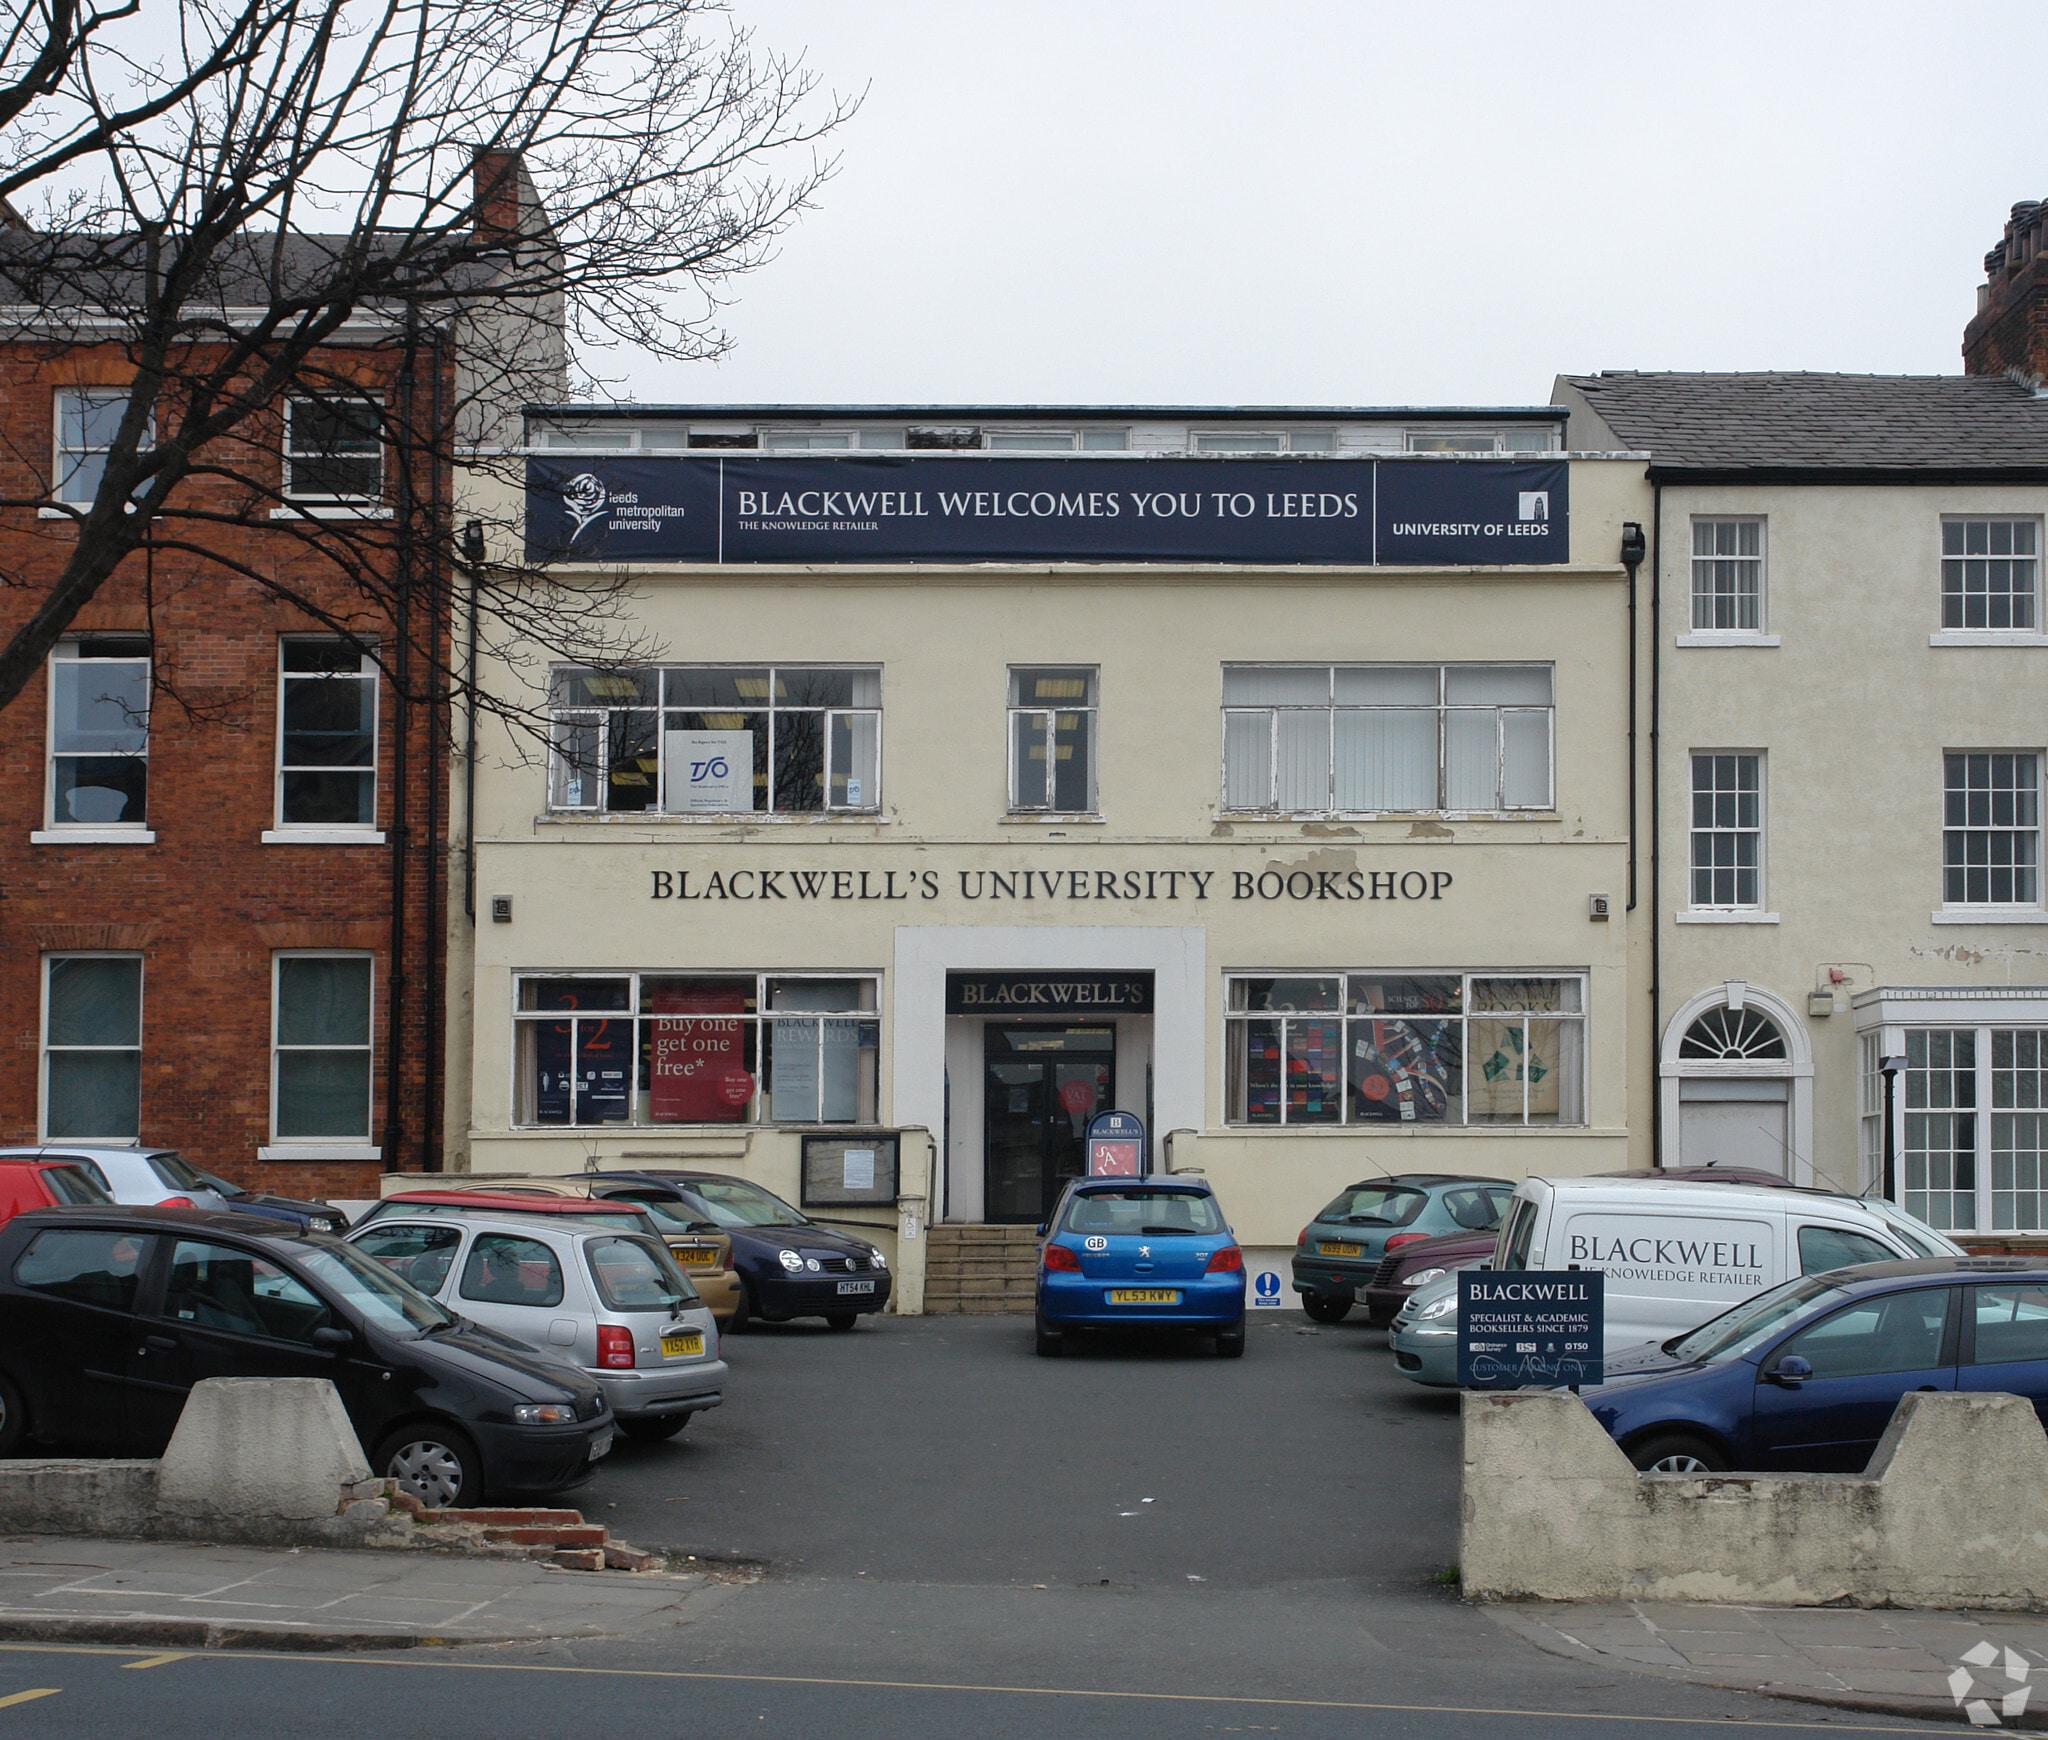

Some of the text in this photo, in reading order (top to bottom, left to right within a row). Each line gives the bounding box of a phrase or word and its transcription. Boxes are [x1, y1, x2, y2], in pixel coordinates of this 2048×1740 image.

[609, 492, 638, 503] leeds
[738, 491, 1358, 518] BLACKWELL WELCOMES YOU TO LEEDS
[616, 505, 685, 520] metropolitan
[608, 519, 662, 532] university
[738, 521, 879, 531] THE KNOWLEDGE RETAILER
[1393, 524, 1549, 536] UNIVERSITY OF LEEDS
[690, 756, 729, 782] TSO
[650, 870, 1453, 901] BLACKWELL'S UNIVERSITY BOOKSHOP
[962, 983, 1144, 1004] BLACKWELL'S
[658, 1018, 738, 1036] Buy one
[657, 1038, 730, 1056] get one
[1087, 1238, 1105, 1249] GB
[1570, 1235, 1763, 1269] BLACKWELL
[1603, 1267, 1763, 1286] KNOWLEDGE RETAILER
[1116, 1290, 1173, 1302] YL53 KWY
[1470, 1284, 1589, 1301] BLACKWELL
[1470, 1313, 1589, 1323] SPECIALIST & ACADEMIC
[1470, 1324, 1589, 1333] BOOKSELLERS SINCE 1879
[1573, 1342, 1589, 1350] TSO
[1469, 1362, 1518, 1372] CUSTOMER
